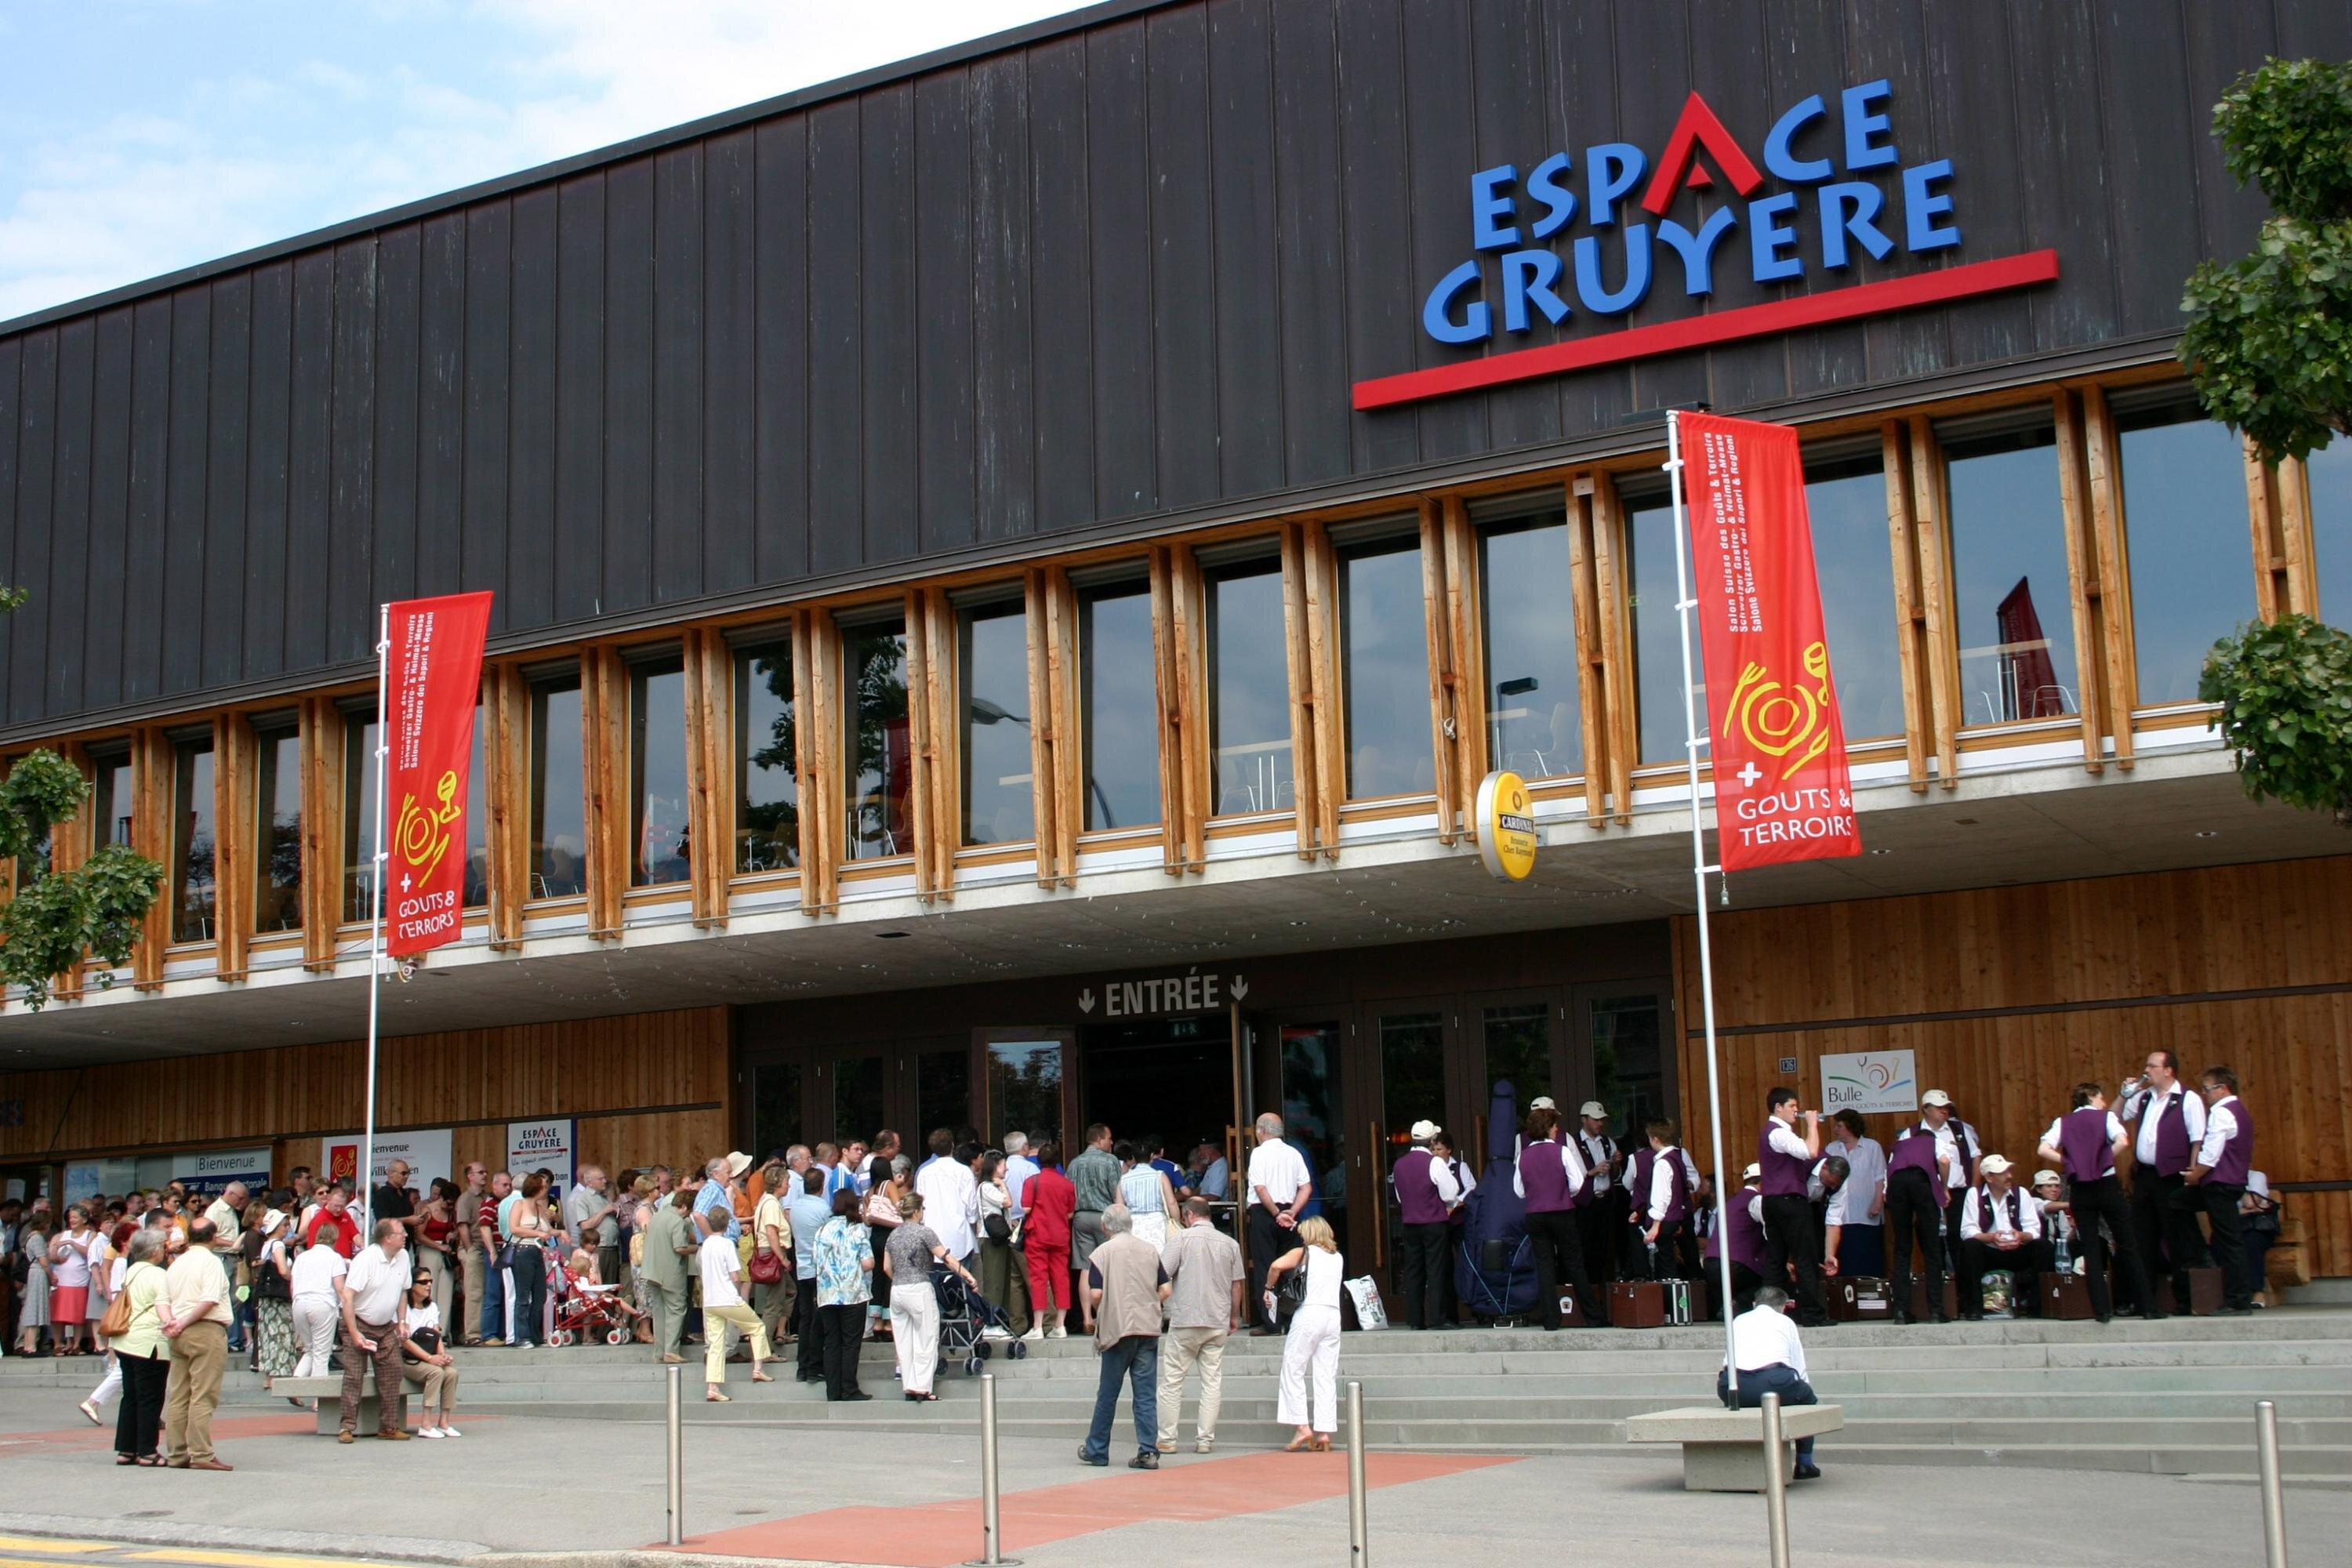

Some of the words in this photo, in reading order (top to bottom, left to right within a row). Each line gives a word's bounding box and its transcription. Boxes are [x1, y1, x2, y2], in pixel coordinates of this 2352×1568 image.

[1472, 79, 1899, 252] ESPACE
[1423, 158, 1962, 345] GRUYERE
[1704, 433, 1718, 475] Terroirs
[1725, 434, 1738, 474] Regioni
[1713, 492, 1726, 524] Goûts
[1733, 489, 1745, 524] Sapori
[1719, 529, 1729, 549] des
[1723, 554, 1734, 593] Suisse
[1728, 599, 1738, 632] Salon
[1737, 574, 1748, 632] Schweizer
[1748, 597, 1762, 632] Salone
[423, 612, 434, 643] Regioni
[418, 655, 428, 681] Sapori
[416, 684, 425, 698] dei
[413, 700, 423, 736] Svizzero
[1737, 788, 1831, 819] GOUTS
[1838, 788, 1851, 808] &
[1501, 815, 1534, 833] CARDINAL
[1738, 815, 1852, 847] TERROIRS
[399, 892, 443, 918] GOUTS
[398, 910, 454, 939] TERRORS
[1105, 967, 1220, 1016] ENTRÉE
[1828, 1087, 1862, 1102] Bulle
[518, 1138, 561, 1149] GRUYERE
[523, 1126, 557, 1139] ESPACE
[198, 1156, 256, 1171] Bienvenue
[372, 1144, 410, 1154] ienvenue
[205, 1181, 226, 1192] Banqu
